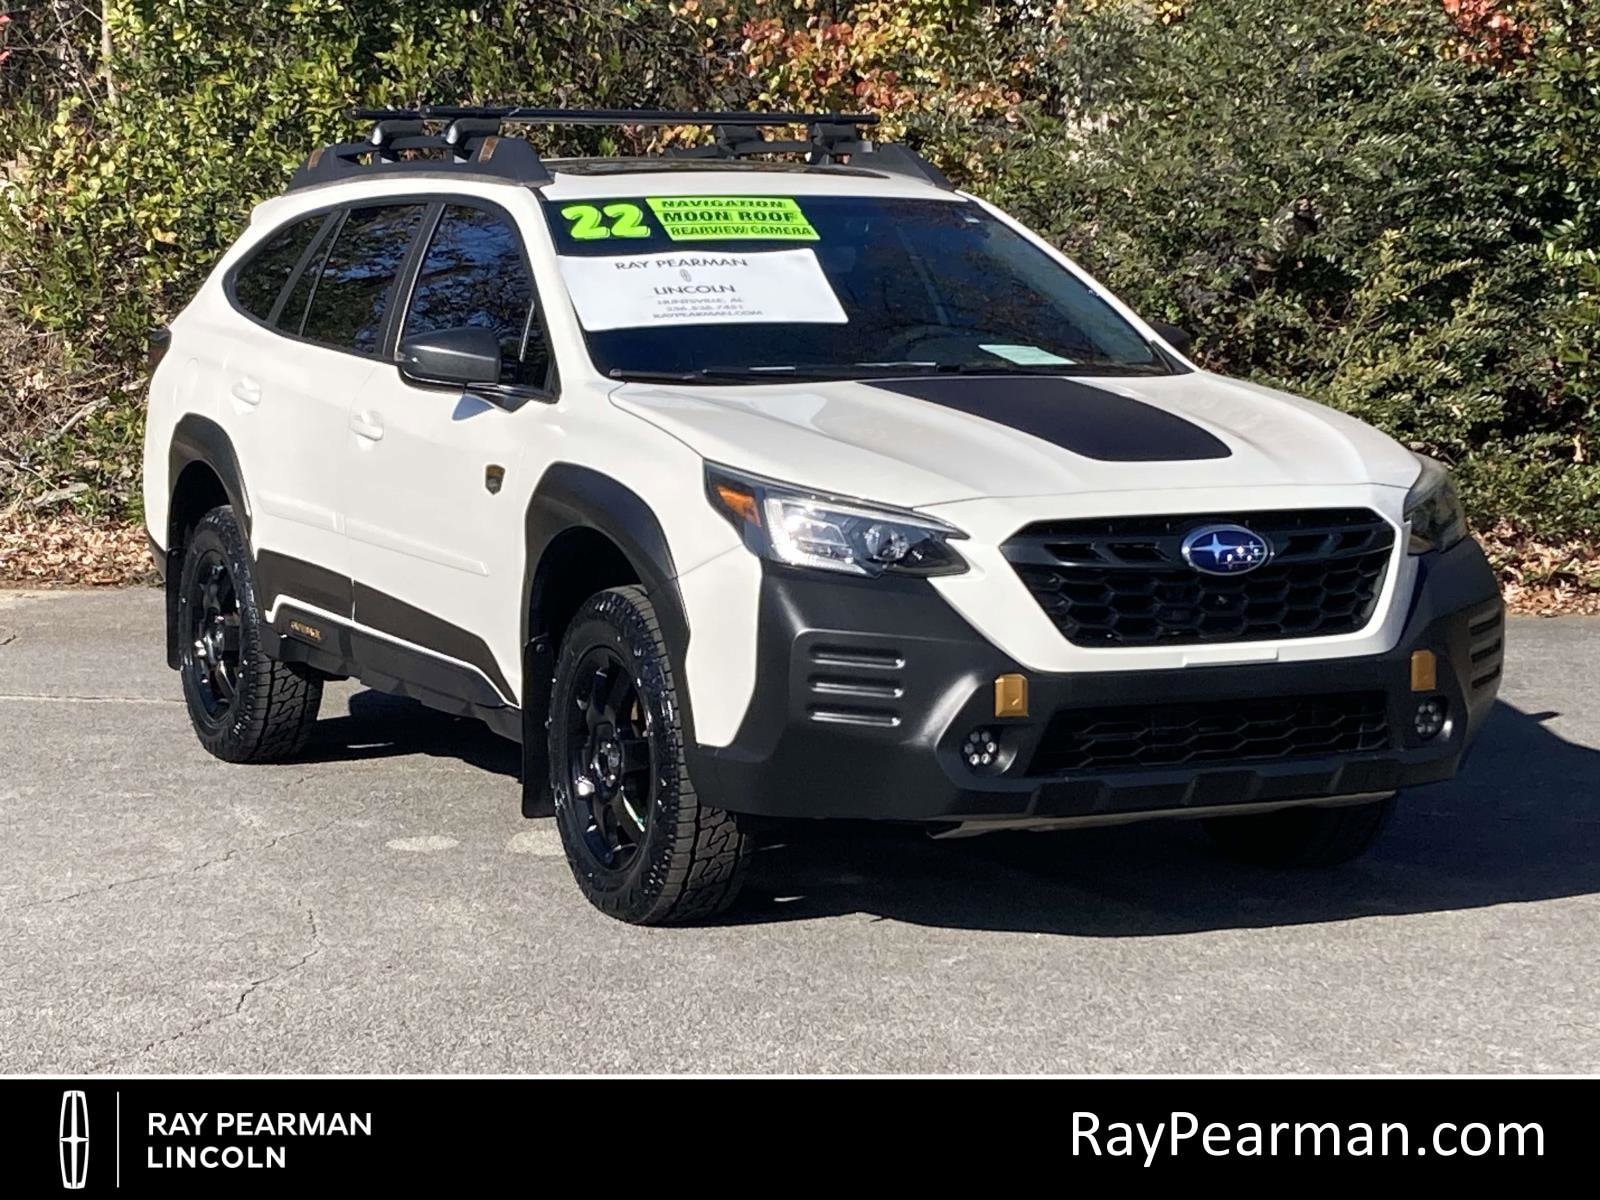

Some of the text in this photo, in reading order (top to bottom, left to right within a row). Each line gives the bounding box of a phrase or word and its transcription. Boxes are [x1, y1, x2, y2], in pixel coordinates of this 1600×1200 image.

[660, 199, 786, 209] NAVIGATION
[561, 203, 651, 240] 22
[662, 210, 795, 223] MOON ROOF
[670, 224, 813, 237] REARVIEW CAMERA
[614, 257, 749, 271] RAY PEARMAN
[653, 284, 736, 296] LINCOLN
